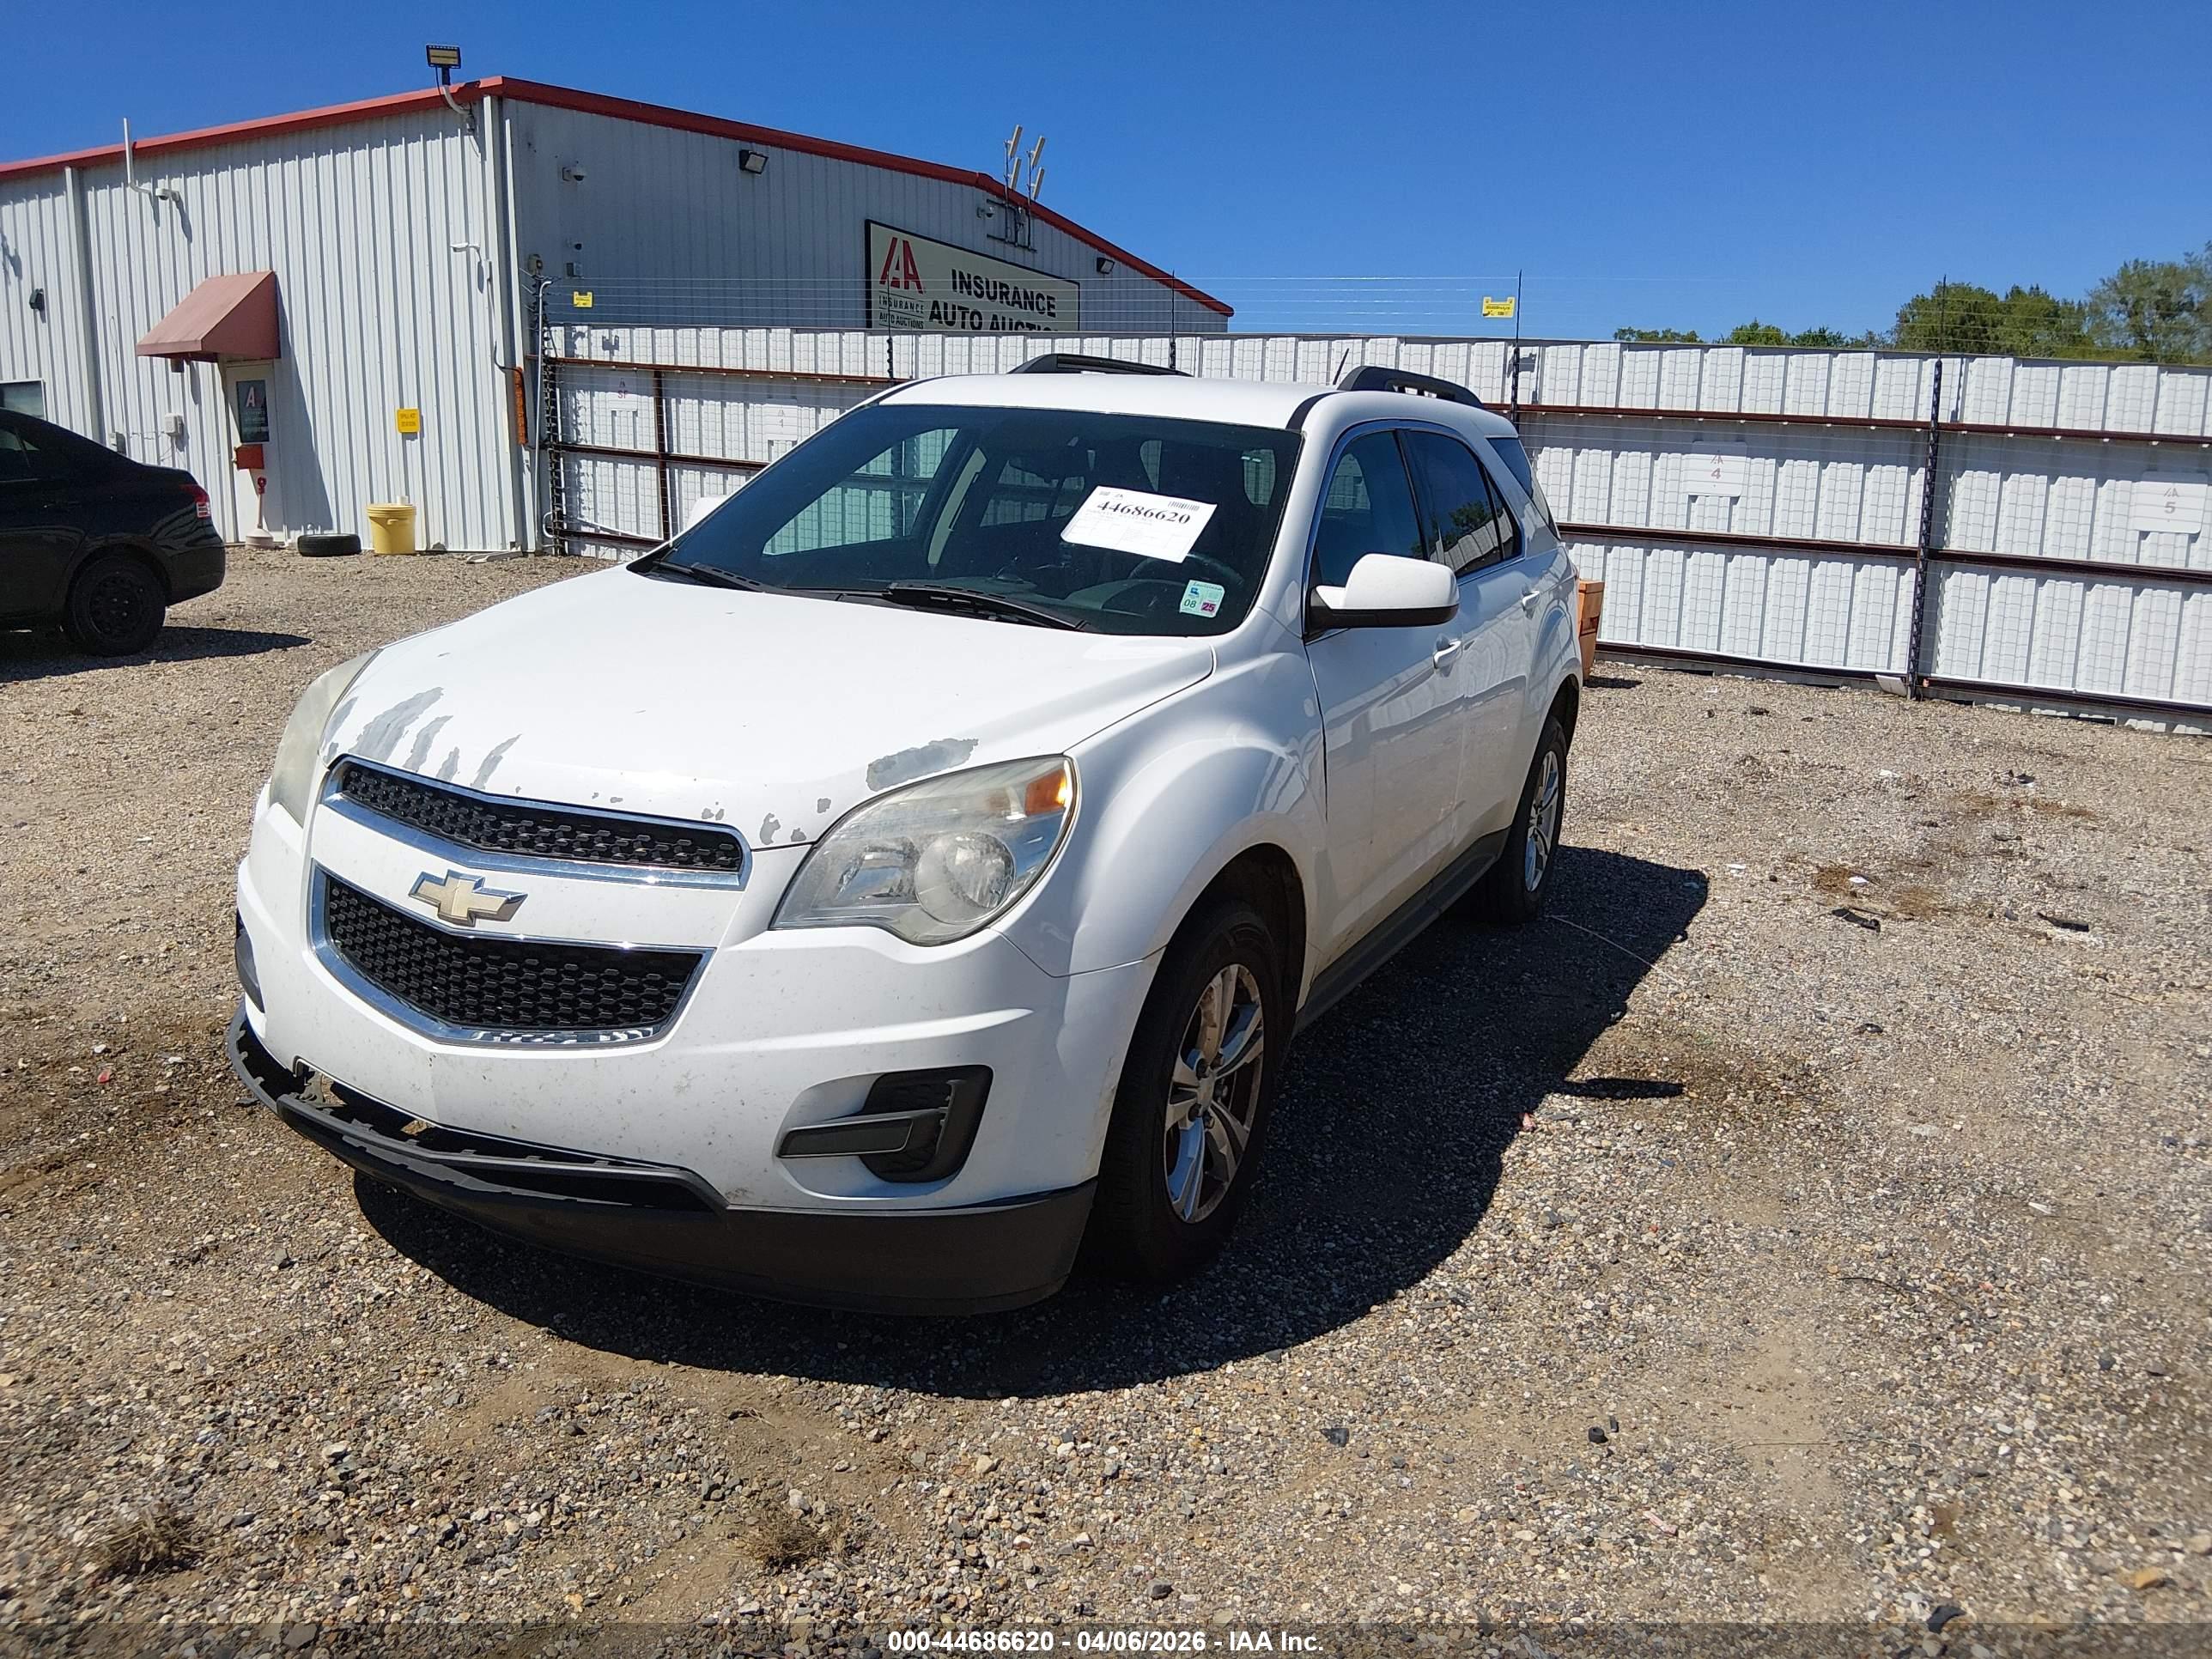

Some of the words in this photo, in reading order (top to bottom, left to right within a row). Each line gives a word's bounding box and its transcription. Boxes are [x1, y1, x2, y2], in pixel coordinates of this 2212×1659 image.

[951, 269, 1056, 318] INSURANCE
[878, 295, 924, 313] INSURANCE
[896, 315, 924, 329] AUCTIONS
[929, 300, 983, 331] AUTO
[1711, 468, 1721, 479] 4
[1097, 501, 1191, 525] 44686620
[2164, 501, 2176, 514] 5
[1184, 599, 1197, 608] 08
[1201, 602, 1217, 612] 25
